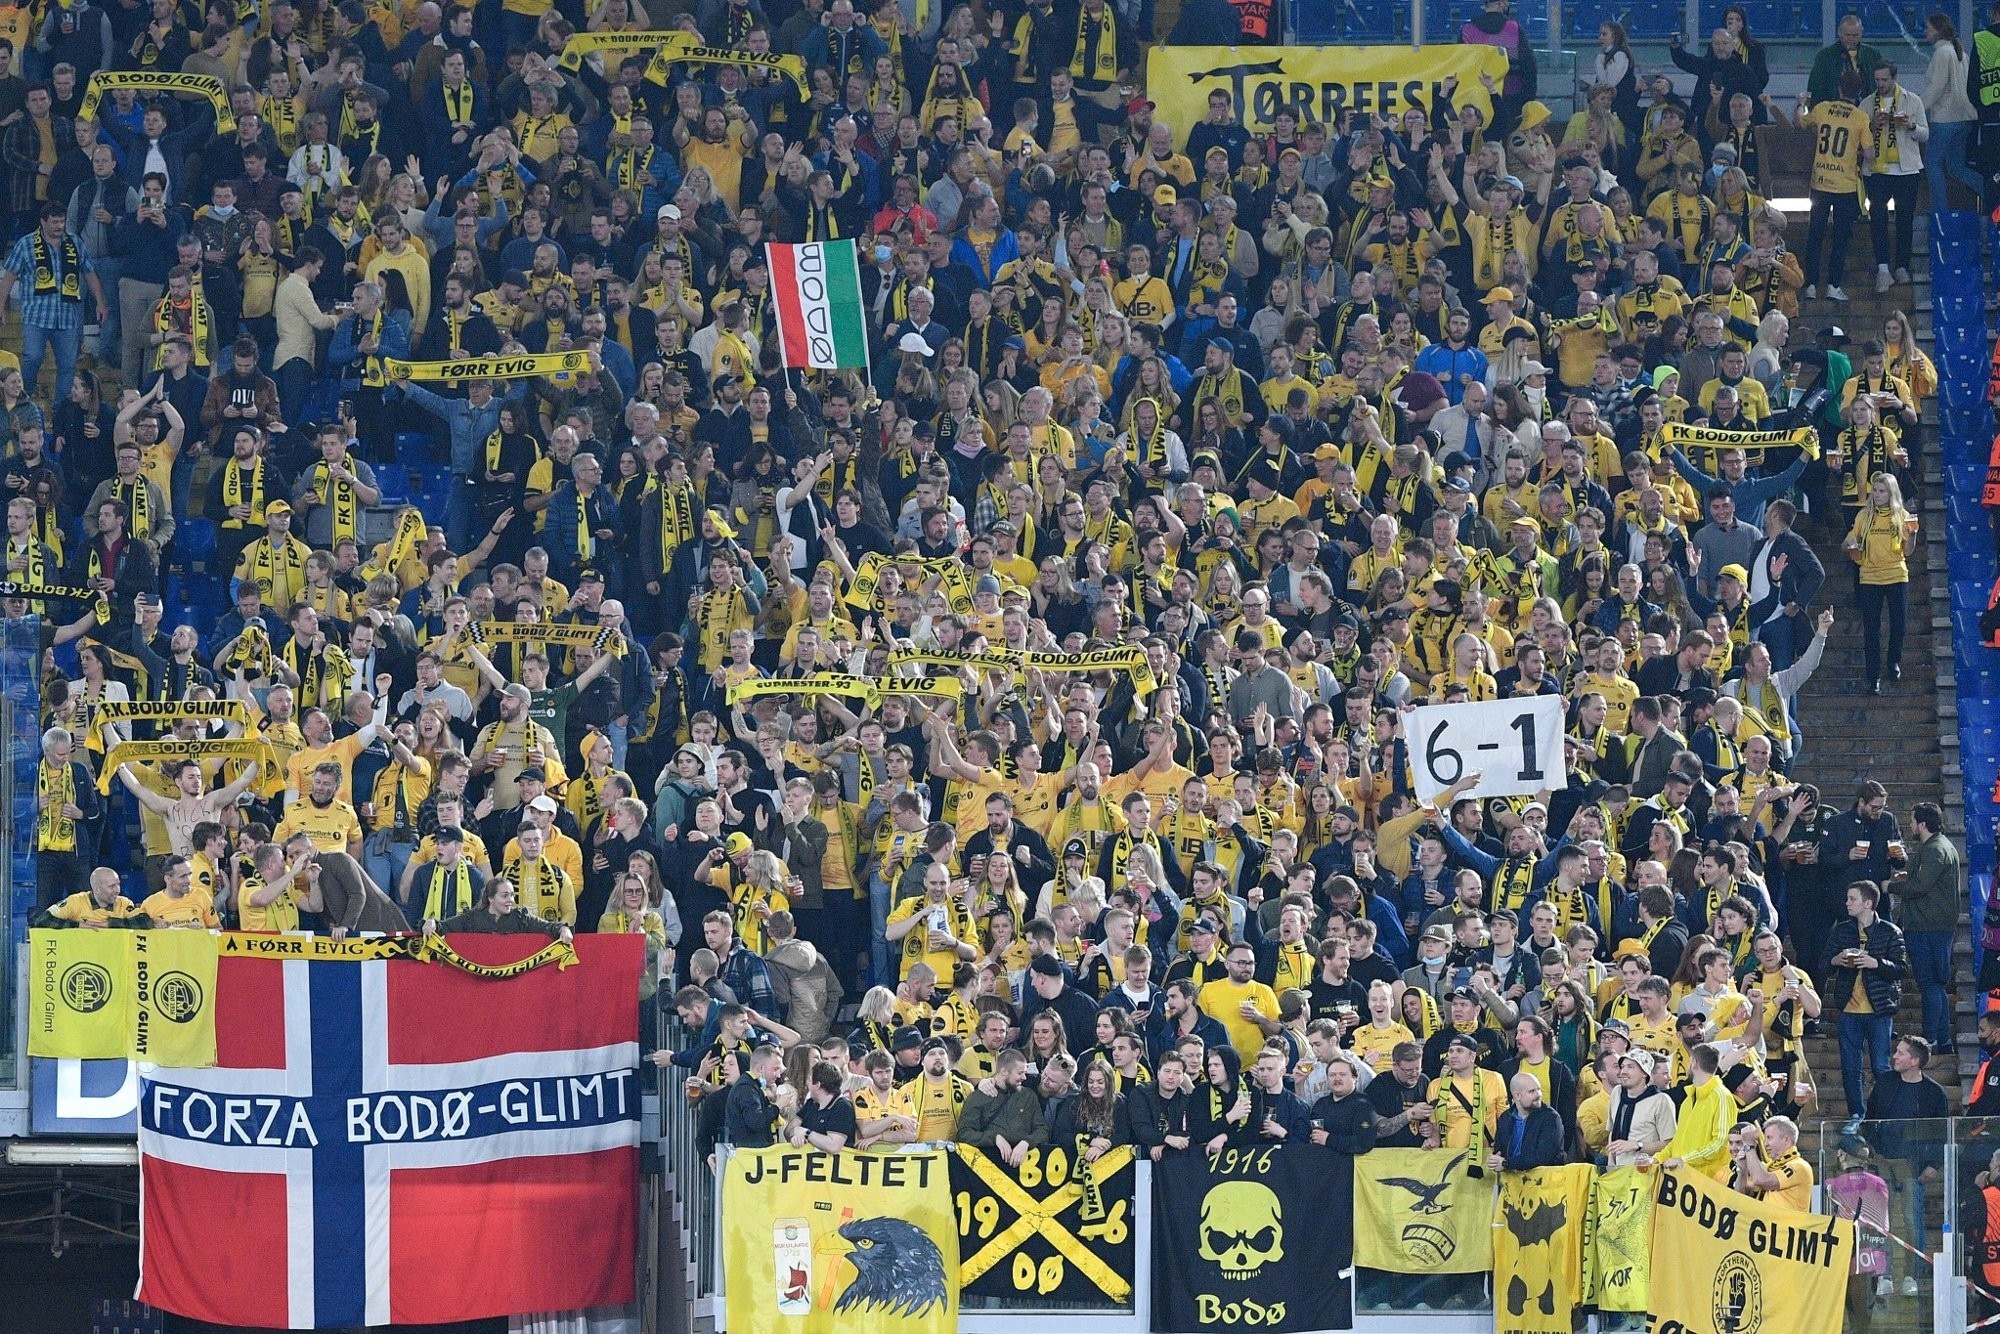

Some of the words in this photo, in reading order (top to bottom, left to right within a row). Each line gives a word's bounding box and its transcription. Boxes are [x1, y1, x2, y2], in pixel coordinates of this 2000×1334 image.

[737, 50, 783, 64] EVIG
[94, 72, 114, 87] FK
[1819, 124, 1849, 158] 30
[799, 244, 834, 364] BODØ
[441, 361, 491, 377] FØRR
[495, 359, 536, 374] EVIG
[1672, 426, 1690, 439] FK
[1695, 427, 1796, 443] BODØ/GLIMT
[338, 505, 350, 526] FK
[1030, 649, 1139, 664] BODØ/GLIMT
[888, 676, 937, 690] EVIG
[45, 940, 57, 957] FK
[136, 934, 147, 953] FK
[246, 939, 303, 953] FØRR
[314, 941, 364, 955] EVIG
[153, 1085, 318, 1147] FORZA
[347, 1069, 633, 1143] BODØ-GLIMT
[745, 1152, 938, 1188] J-FELTET
[1019, 1147, 1068, 1187] BO
[1208, 1147, 1272, 1175] 1916
[956, 1191, 1000, 1237] 19
[1658, 1172, 1739, 1241] BODØ
[1749, 1214, 1840, 1268] GLIMT
[1012, 1252, 1065, 1295] DØ
[1195, 1294, 1287, 1326] Bodø
